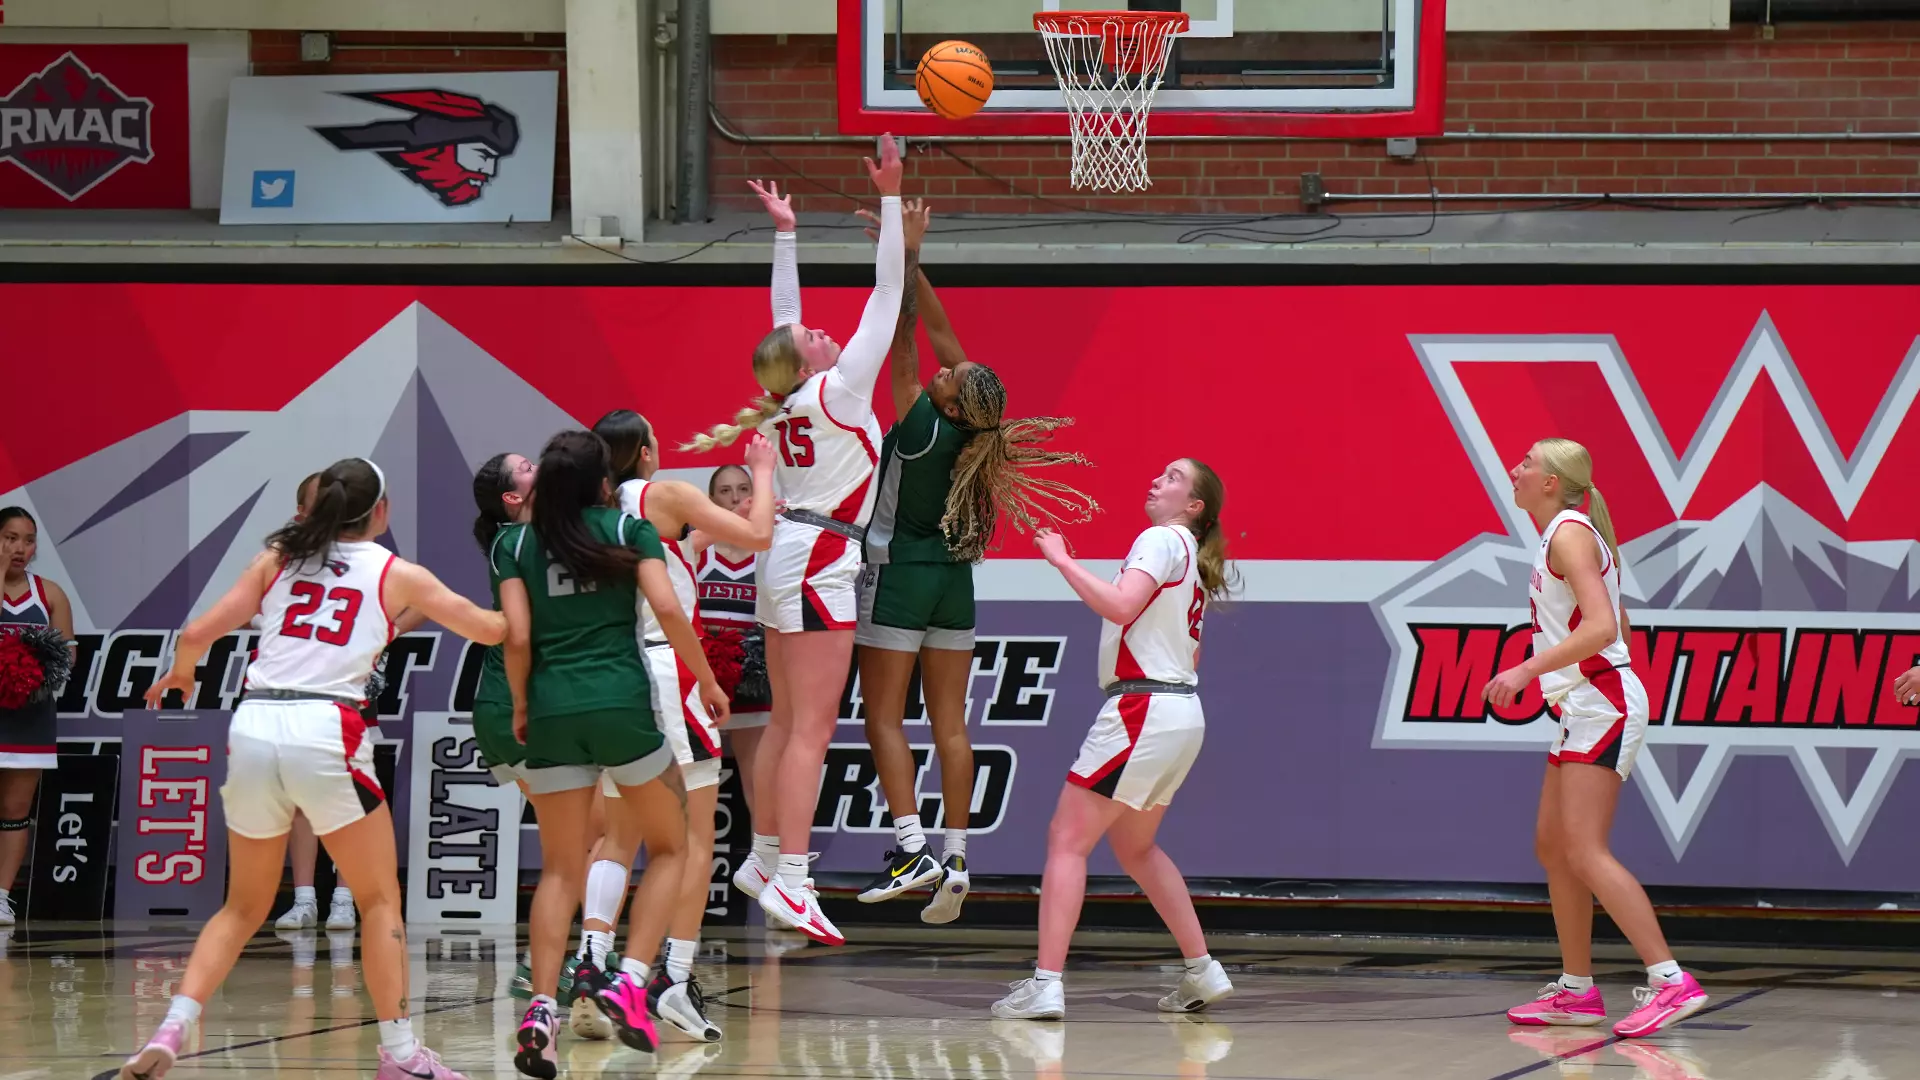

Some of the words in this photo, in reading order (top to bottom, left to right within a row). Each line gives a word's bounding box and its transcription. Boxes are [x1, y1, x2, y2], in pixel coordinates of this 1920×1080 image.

[0, 108, 142, 150] RMAC
[774, 416, 815, 468] 15
[546, 549, 598, 598] 2
[279, 579, 364, 647] 23
[1402, 622, 1920, 731] MONTAINE
[135, 745, 210, 884] LET'S
[427, 737, 499, 899] SLATE
